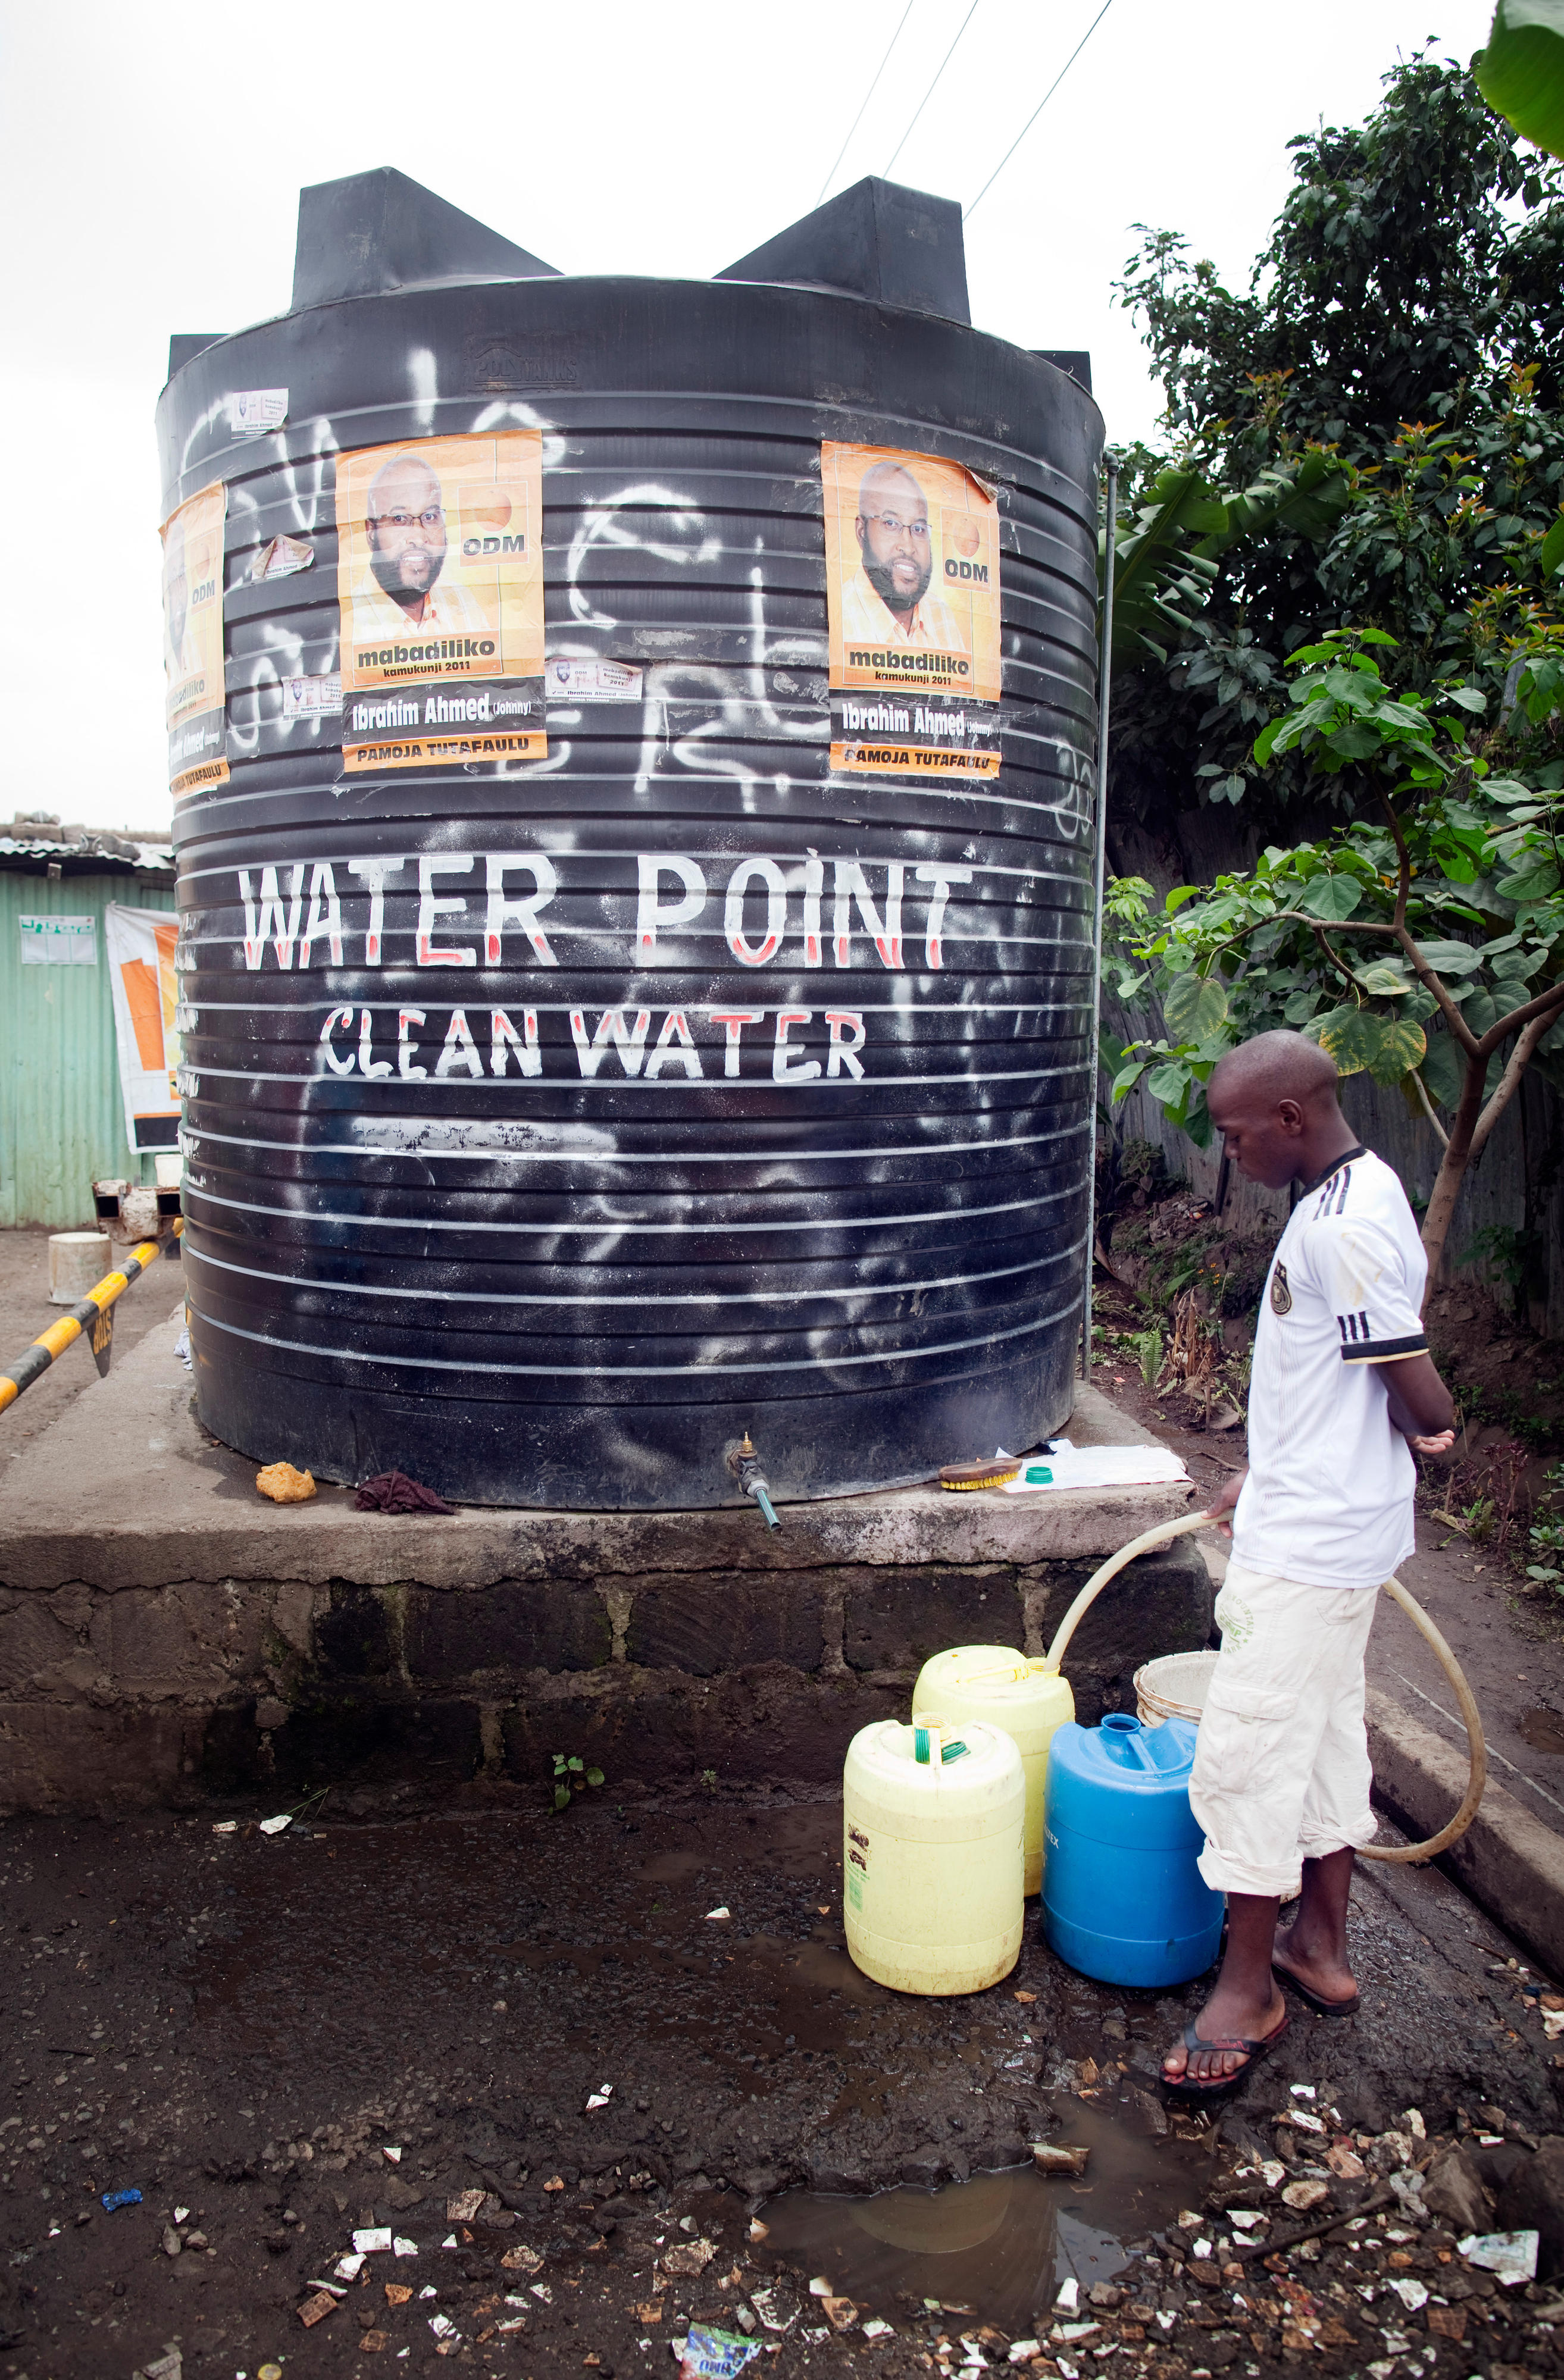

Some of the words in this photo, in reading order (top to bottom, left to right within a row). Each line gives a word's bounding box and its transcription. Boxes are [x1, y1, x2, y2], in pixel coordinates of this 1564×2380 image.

[463, 535, 524, 556] ODM
[945, 559, 988, 583] ODM
[192, 580, 215, 605] ODM
[358, 639, 495, 668] mabadiliko
[849, 651, 969, 675] mabadiliko
[383, 663, 442, 677] kamukunji
[445, 661, 470, 671] 2011
[604, 673, 633, 682] kamukunji
[875, 671, 929, 684] kamukunji
[932, 676, 951, 685] 2011
[352, 699, 419, 731] Ibrahim
[424, 693, 490, 724] Ahmed
[493, 701, 531, 716] (Johnny)
[842, 702, 909, 732] Ibrahim
[914, 707, 965, 736] Ahmed
[358, 744, 422, 762] PAMOJA
[427, 738, 529, 756] TUTAFAULU
[915, 753, 990, 769] TUTAFAULU
[186, 764, 221, 786] TUTAFAULU
[238, 854, 559, 970] WATER
[637, 854, 972, 969] POINT
[320, 1007, 542, 1080] CLEAN
[570, 1009, 866, 1083] WATER
